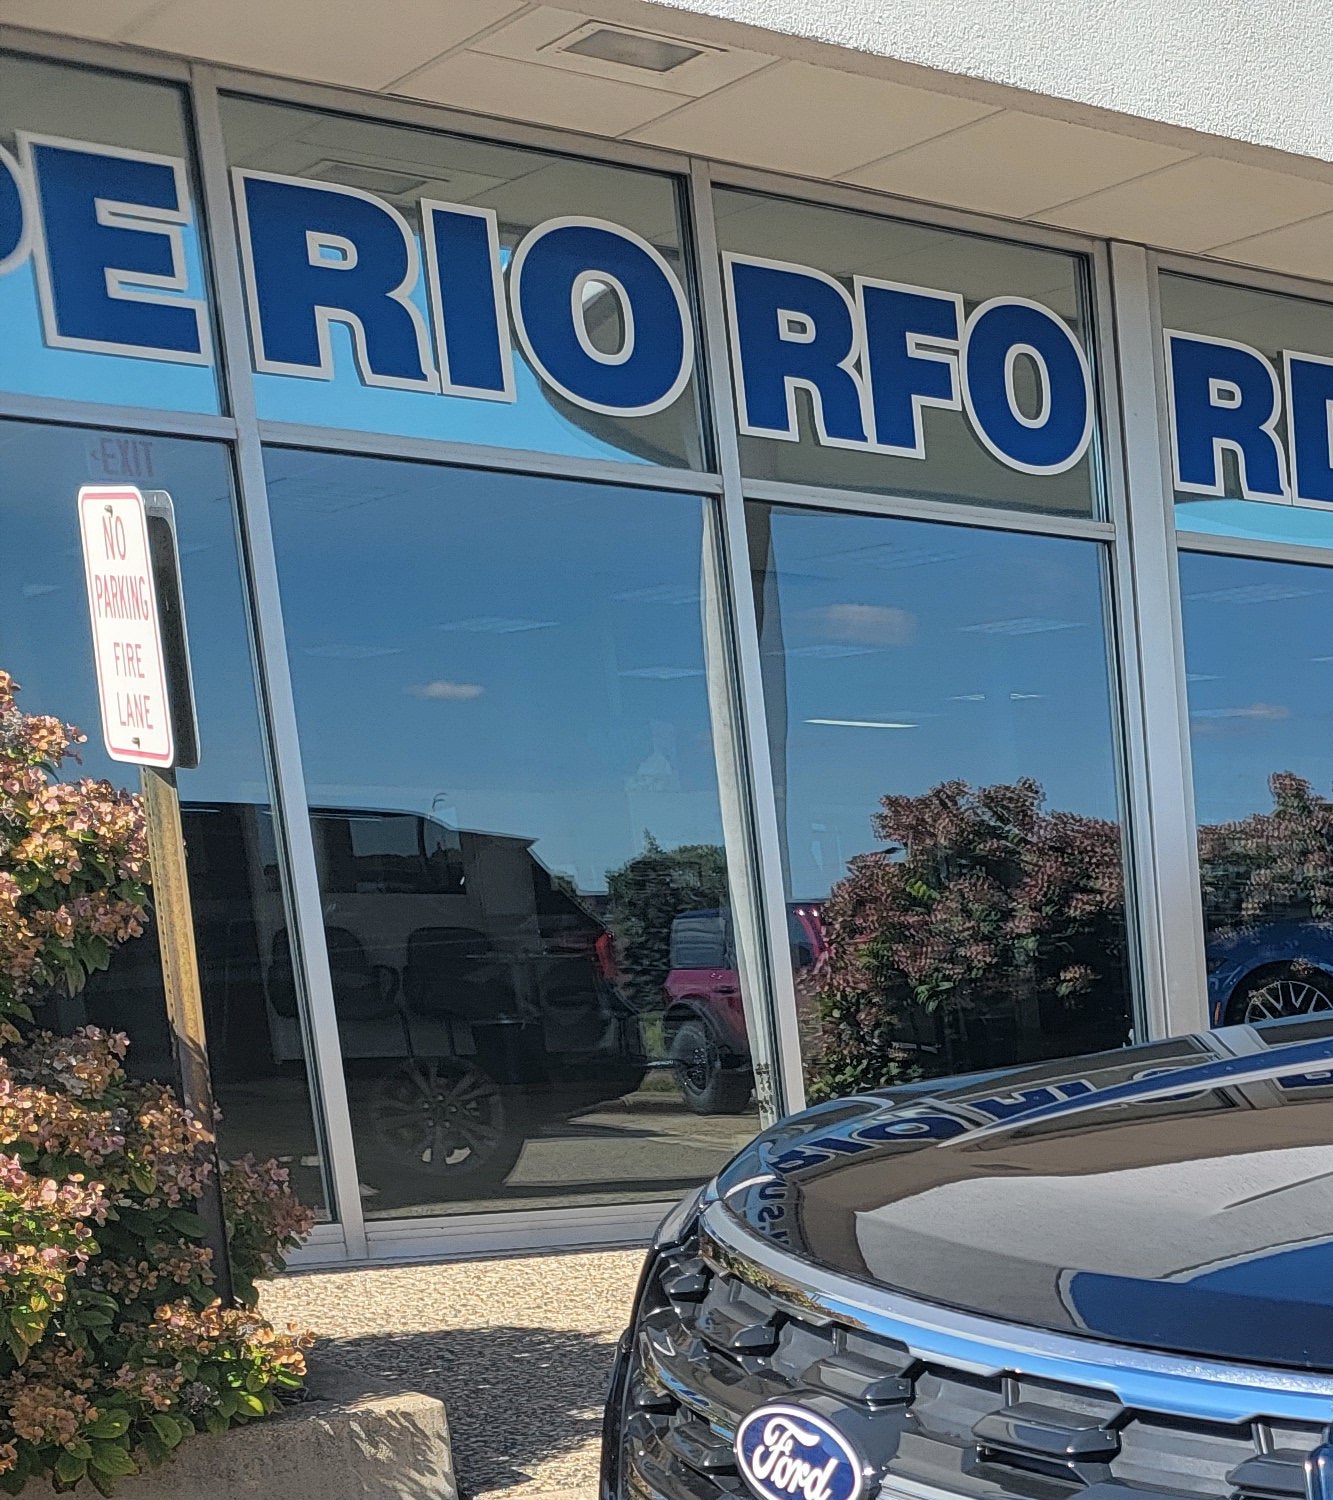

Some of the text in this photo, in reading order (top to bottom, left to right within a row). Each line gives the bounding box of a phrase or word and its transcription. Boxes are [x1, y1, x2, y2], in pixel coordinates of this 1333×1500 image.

[103, 516, 127, 560] NO
[95, 574, 150, 621] PARKING
[113, 641, 145, 679] FIRE
[117, 692, 154, 730] LANE
